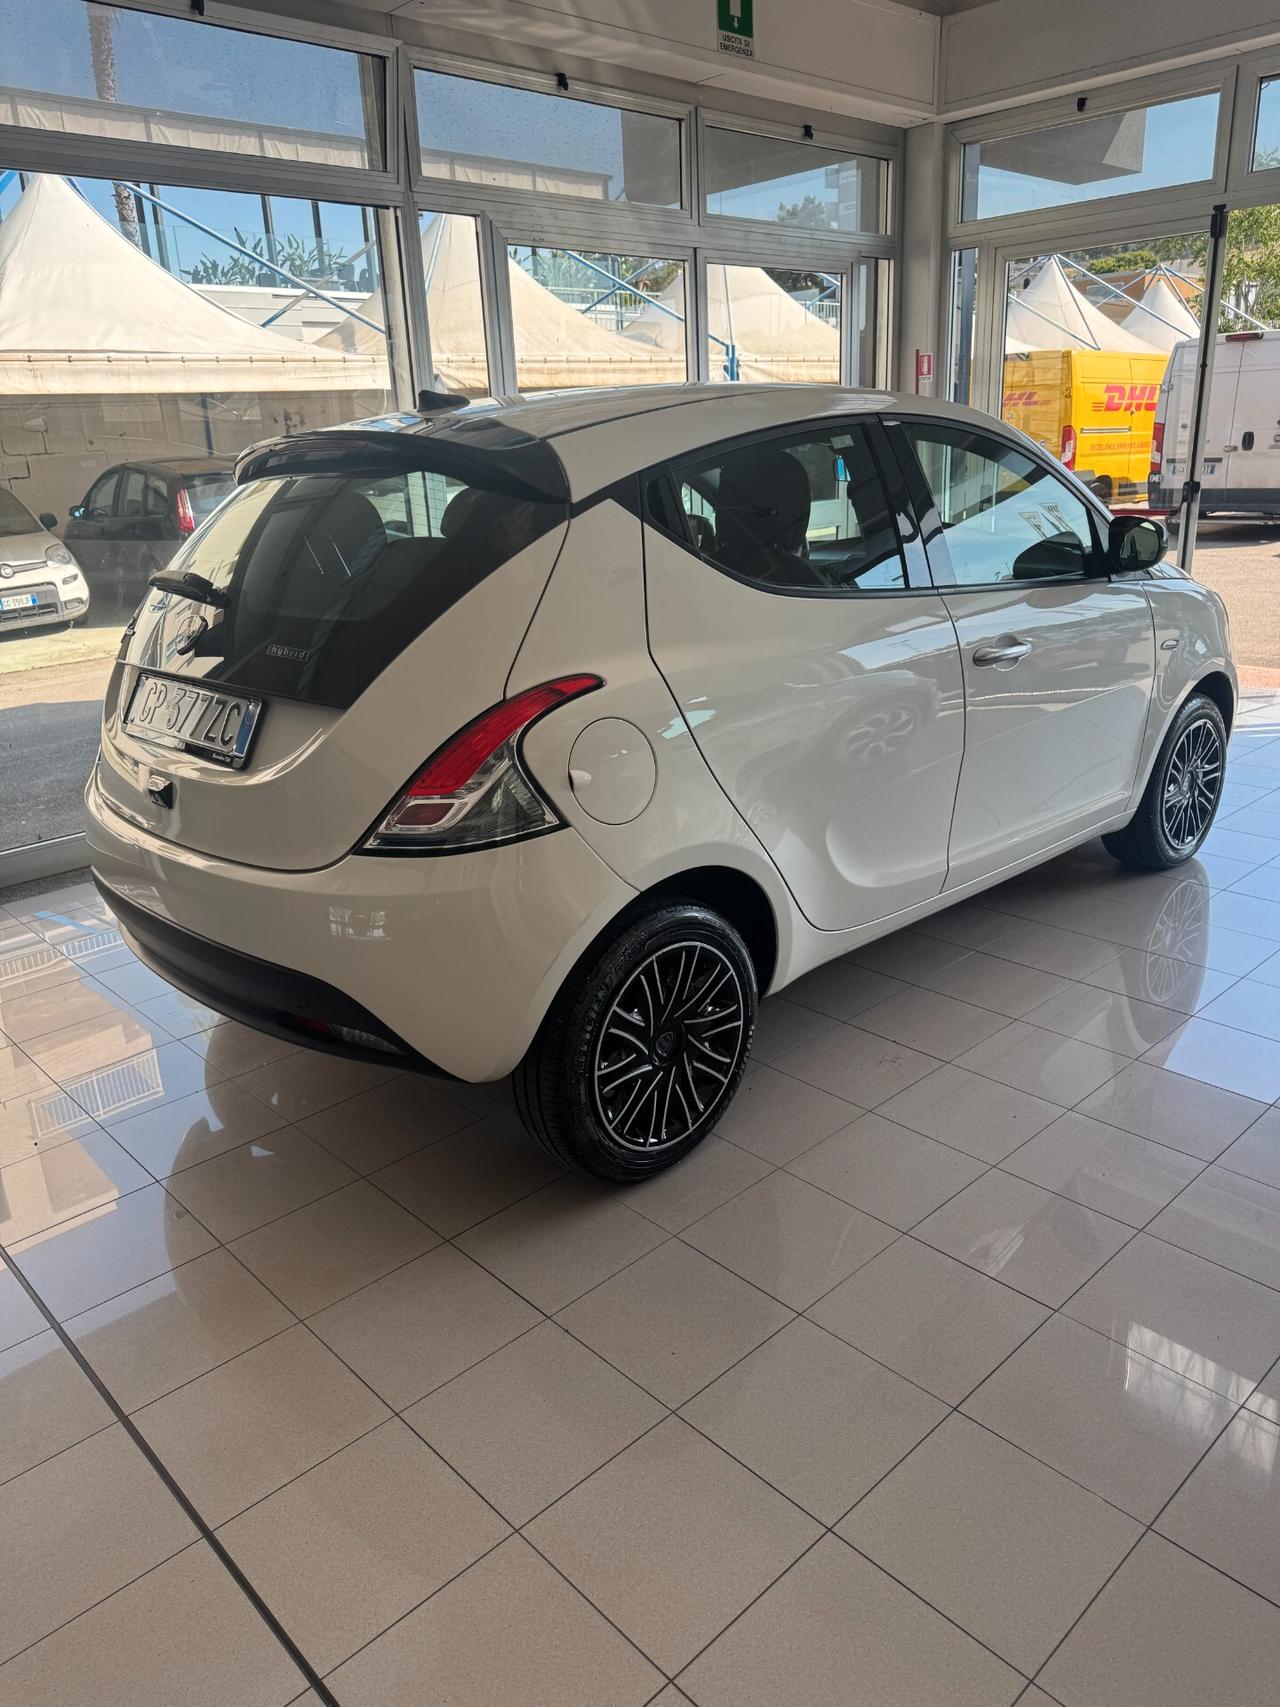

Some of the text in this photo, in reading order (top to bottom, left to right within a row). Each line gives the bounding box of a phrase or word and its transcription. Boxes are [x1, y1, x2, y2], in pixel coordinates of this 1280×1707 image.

[722, 34, 751, 48] USCITA DI
[719, 42, 753, 56] EMERGENZA
[1103, 384, 1157, 412] DHL
[271, 646, 305, 658] hybrid
[165, 687, 241, 746] 377ZC
